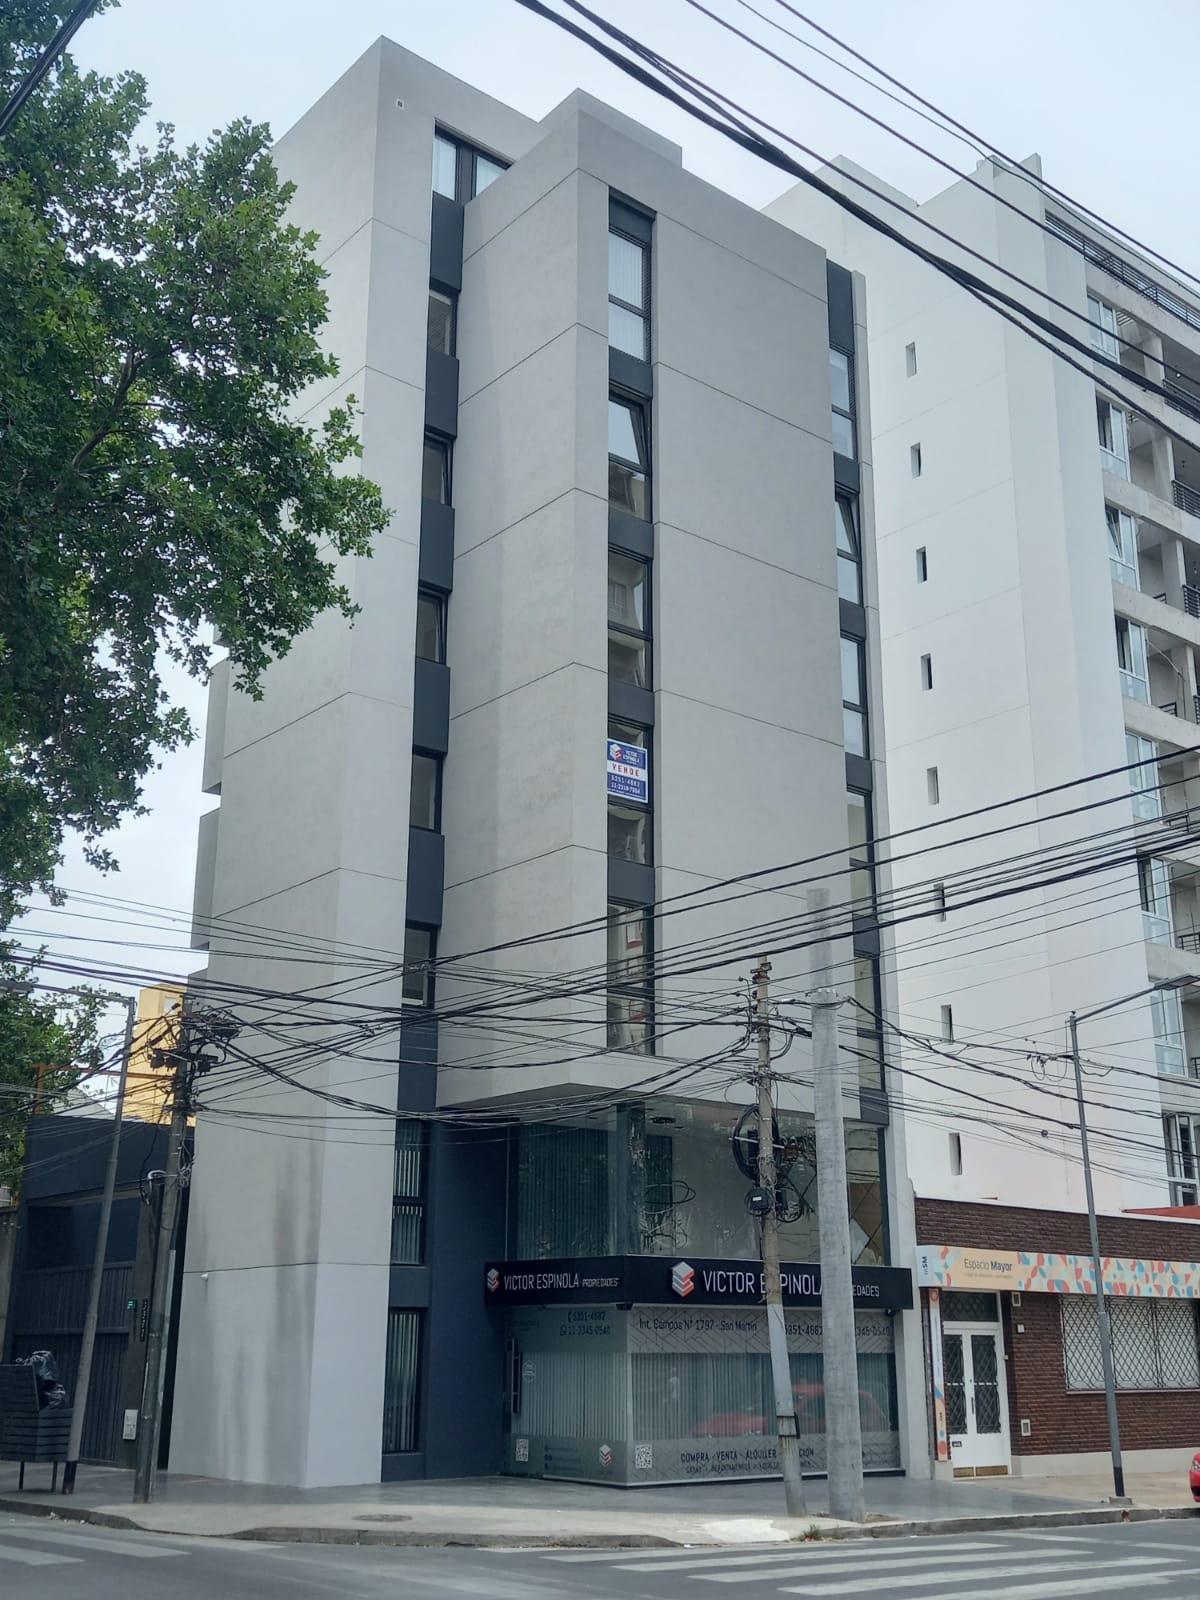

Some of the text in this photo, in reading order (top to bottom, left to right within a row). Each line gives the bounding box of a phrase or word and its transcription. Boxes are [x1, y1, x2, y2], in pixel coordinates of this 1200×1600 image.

[612, 763, 641, 777] VENDE
[964, 1258, 1013, 1272] Espacio Mayor
[504, 1275, 534, 1291] VICTOR
[536, 1272, 580, 1289] ESPINOLA
[703, 1270, 755, 1294] VICTOR
[760, 1272, 822, 1296] EPINOL
[696, 1319, 714, 1331] 1797
[681, 1451, 710, 1463] COMPRA
[716, 1450, 738, 1461] VENTA
[745, 1448, 777, 1460] ALQUILER
